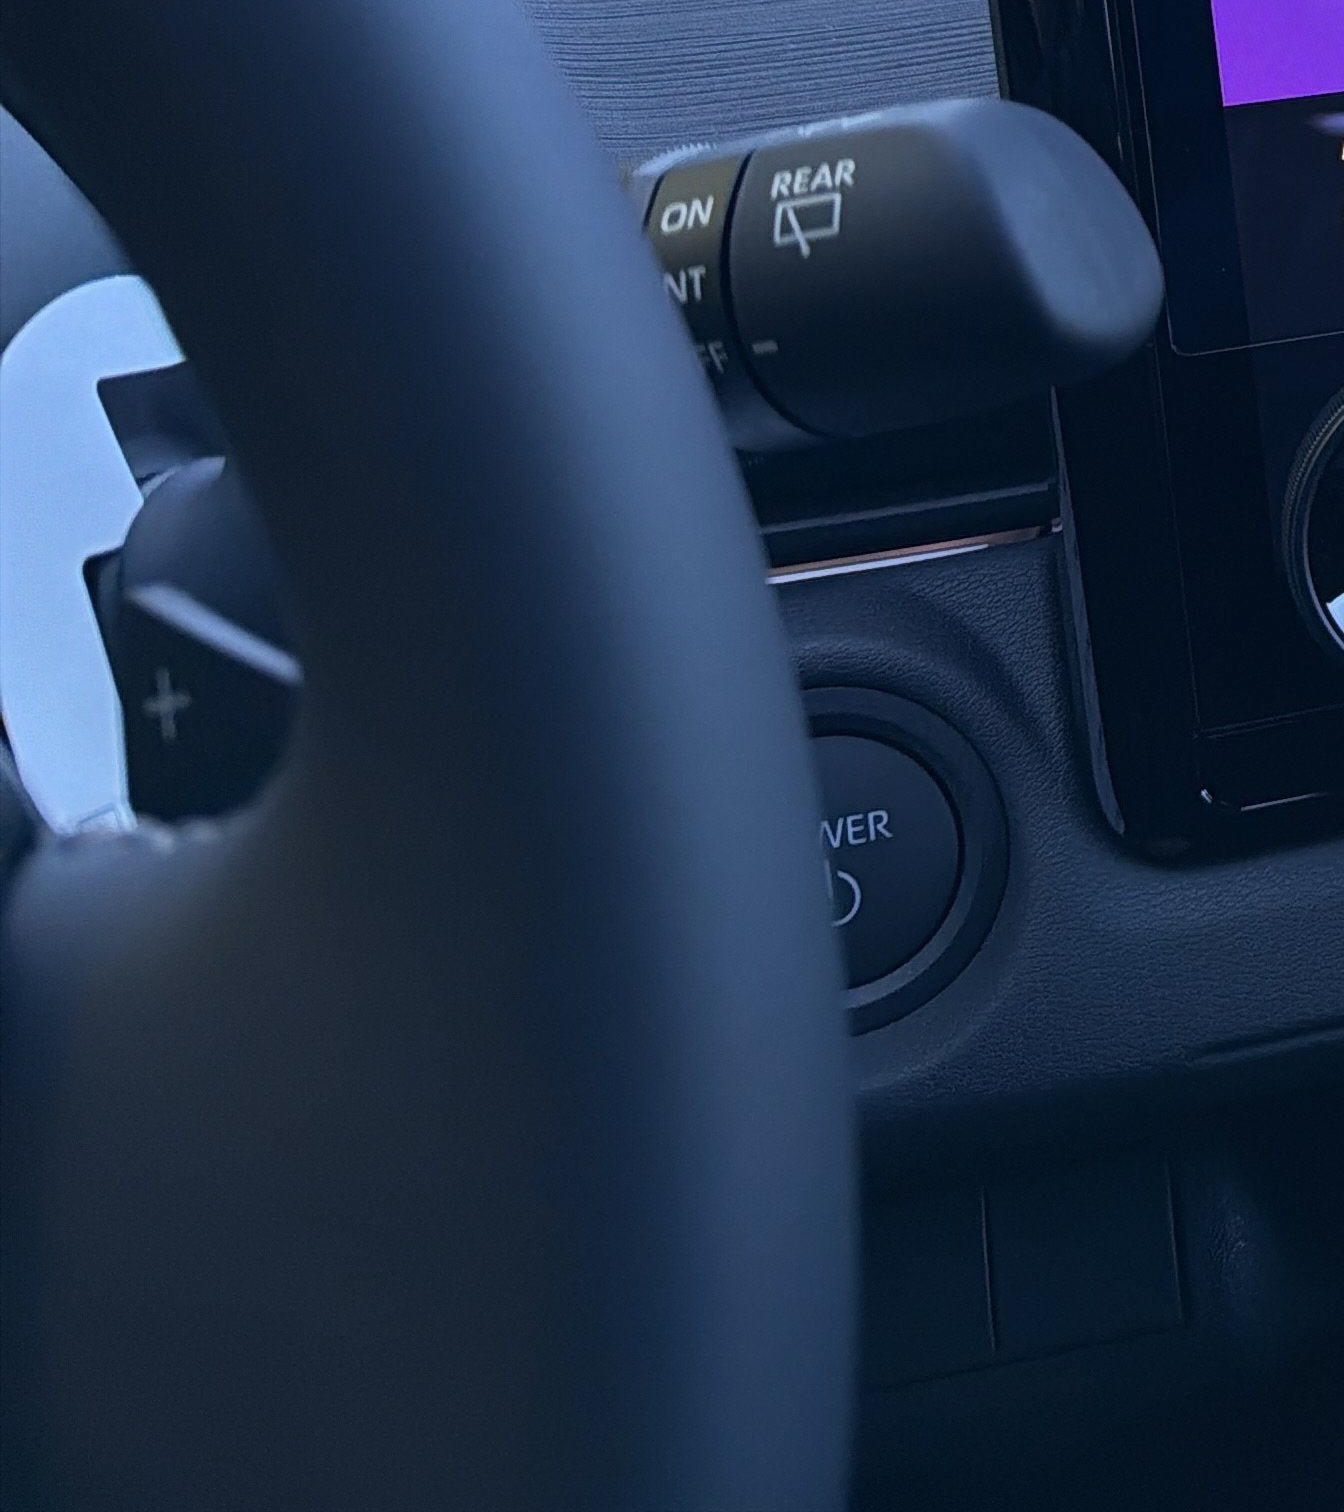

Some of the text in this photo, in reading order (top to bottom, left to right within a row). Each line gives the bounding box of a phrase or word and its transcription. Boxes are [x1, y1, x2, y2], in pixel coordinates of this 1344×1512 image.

[771, 159, 856, 201] REAR
[661, 195, 714, 235] ON
[664, 265, 706, 304] NT
[820, 809, 893, 849] WER
